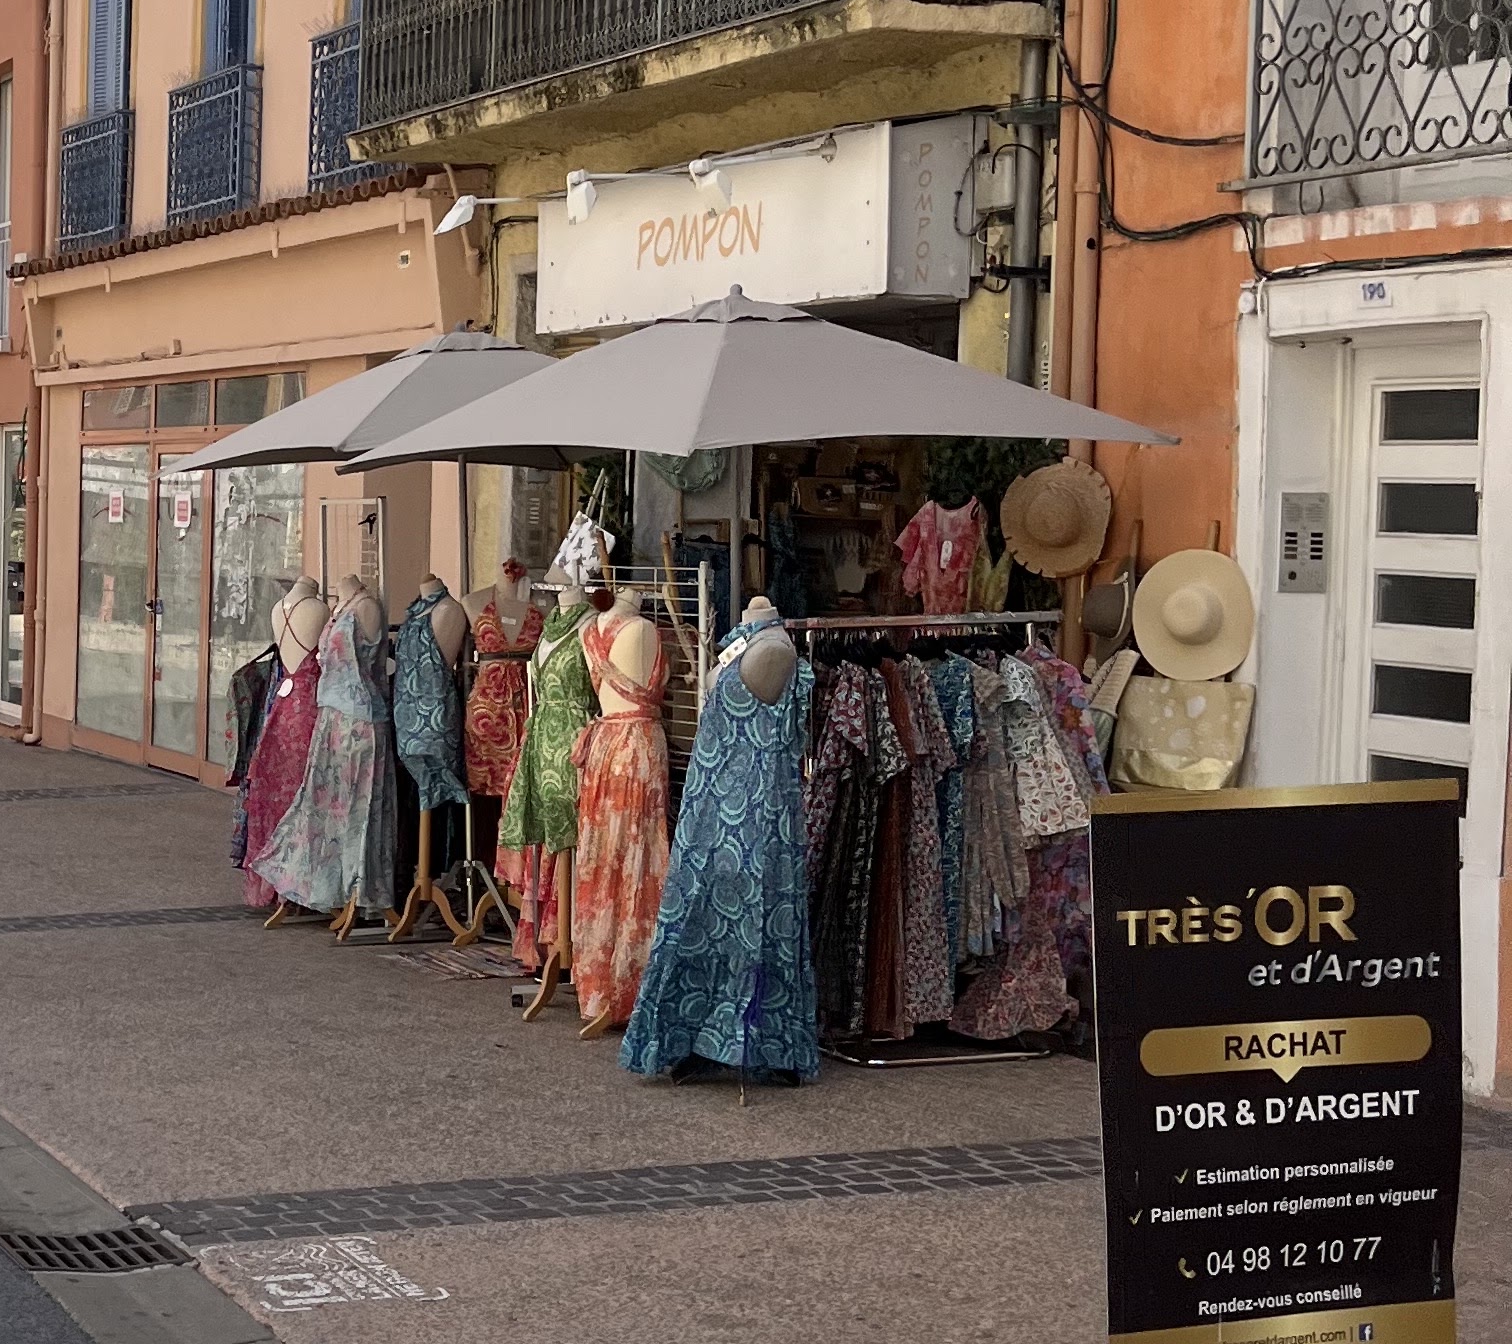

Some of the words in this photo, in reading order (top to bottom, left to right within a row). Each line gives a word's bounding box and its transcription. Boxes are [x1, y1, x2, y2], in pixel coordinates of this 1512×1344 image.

[636, 201, 762, 270] POMPON
[1362, 282, 1386, 301] 190
[1248, 959, 1283, 987] et
[1291, 950, 1441, 987] d'Argent
[1224, 1029, 1347, 1060] RACHAT
[1156, 1101, 1227, 1132] D'OR
[1236, 1099, 1256, 1126] &
[1266, 1089, 1420, 1123] D'ARGENT
[1196, 1165, 1280, 1185] Estimation
[1284, 1156, 1395, 1182] personnalisée
[1150, 1204, 1223, 1223] Paiement
[1226, 1200, 1268, 1216] selon
[1273, 1193, 1352, 1215] réglement
[1355, 1193, 1374, 1205] en
[1379, 1188, 1438, 1206] vigueur
[1206, 1250, 1235, 1277] 04
[1242, 1247, 1271, 1273] 98
[1280, 1242, 1307, 1268] 12
[1318, 1240, 1345, 1264] 10
[1353, 1236, 1383, 1261] 77
[1198, 1292, 1293, 1316] Rendez-vous
[1296, 1283, 1362, 1304] conseillé
